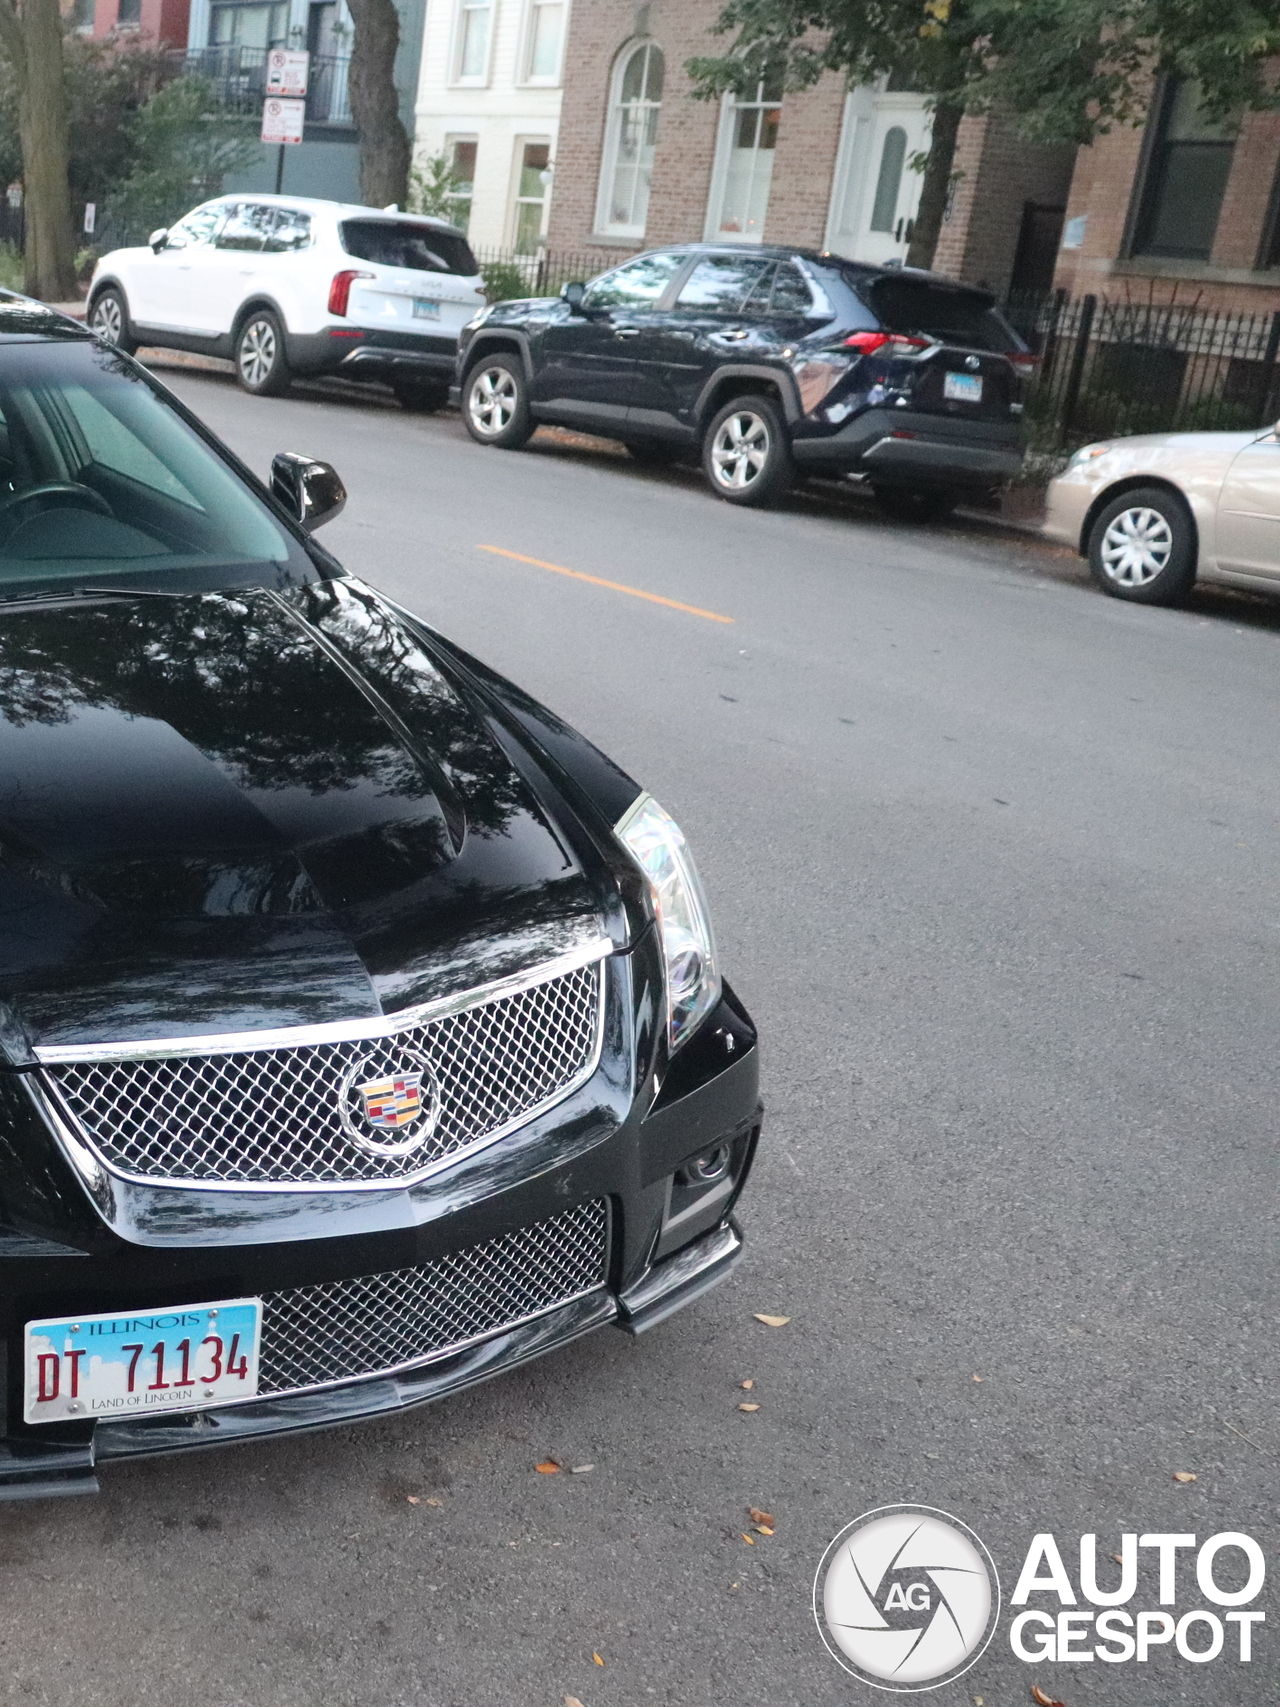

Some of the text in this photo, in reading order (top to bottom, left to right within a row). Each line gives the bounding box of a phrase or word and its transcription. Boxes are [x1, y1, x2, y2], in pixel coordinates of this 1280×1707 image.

[89, 1312, 200, 1336] ILLINOIS
[37, 1333, 248, 1402] DT 71134
